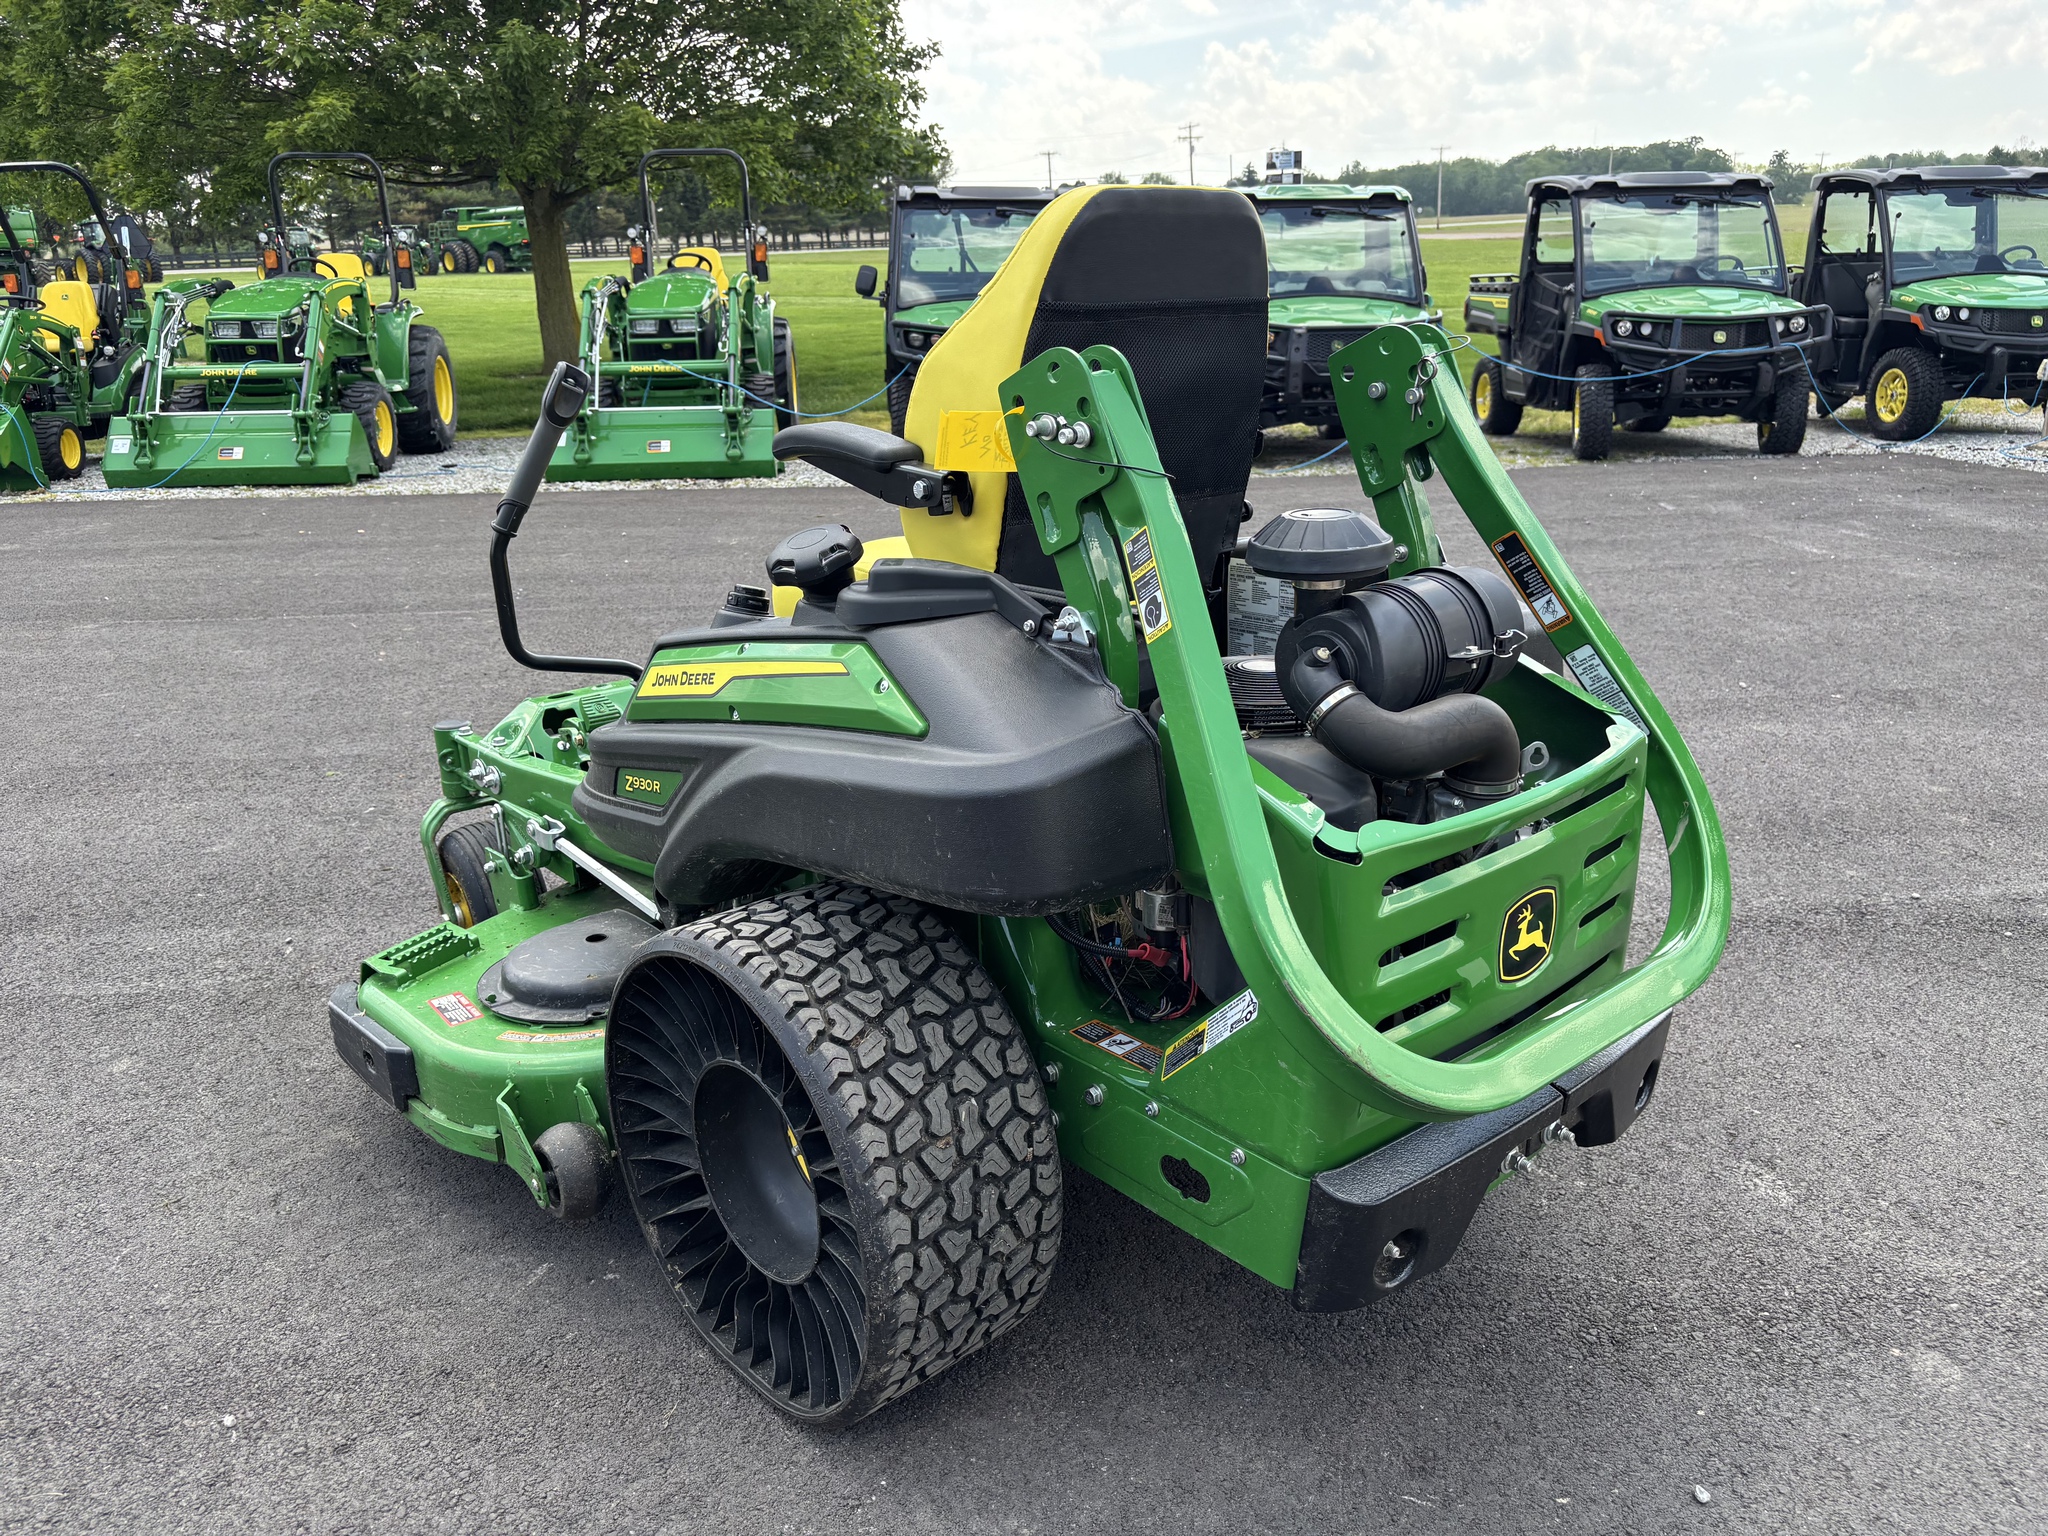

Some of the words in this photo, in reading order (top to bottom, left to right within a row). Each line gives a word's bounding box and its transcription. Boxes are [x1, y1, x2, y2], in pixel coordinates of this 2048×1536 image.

[651, 672, 679, 687] JOHN
[680, 671, 716, 686] DEERE
[625, 774, 661, 794] Z930R
[742, 983, 772, 1017] HIGHWAY
